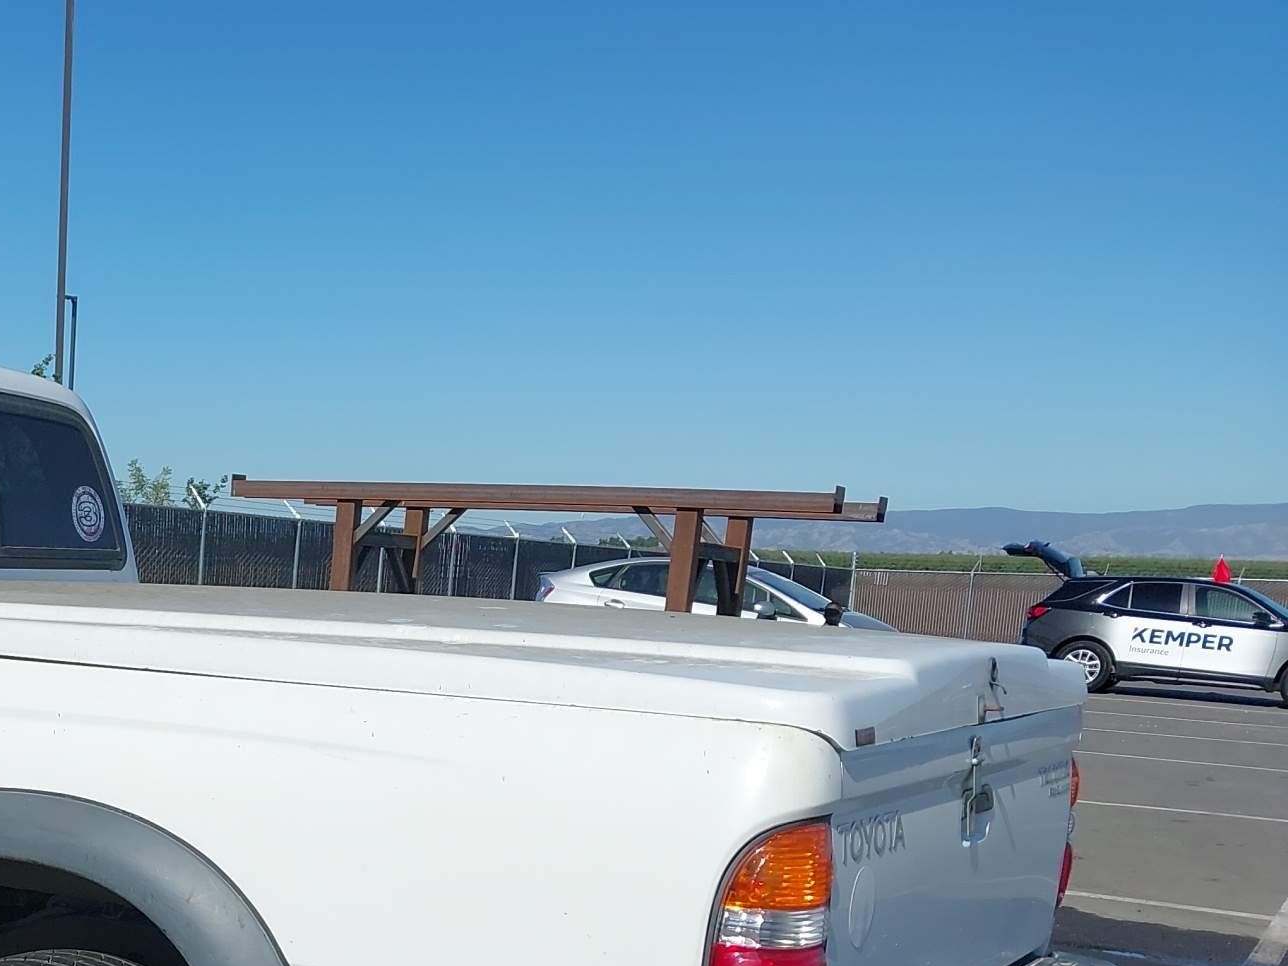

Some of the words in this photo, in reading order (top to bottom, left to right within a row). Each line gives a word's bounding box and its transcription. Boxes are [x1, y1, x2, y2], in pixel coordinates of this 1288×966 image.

[1128, 645, 1169, 656] Insurance
[1131, 626, 1234, 652] KEMPER
[836, 809, 906, 867] TOYOTA
